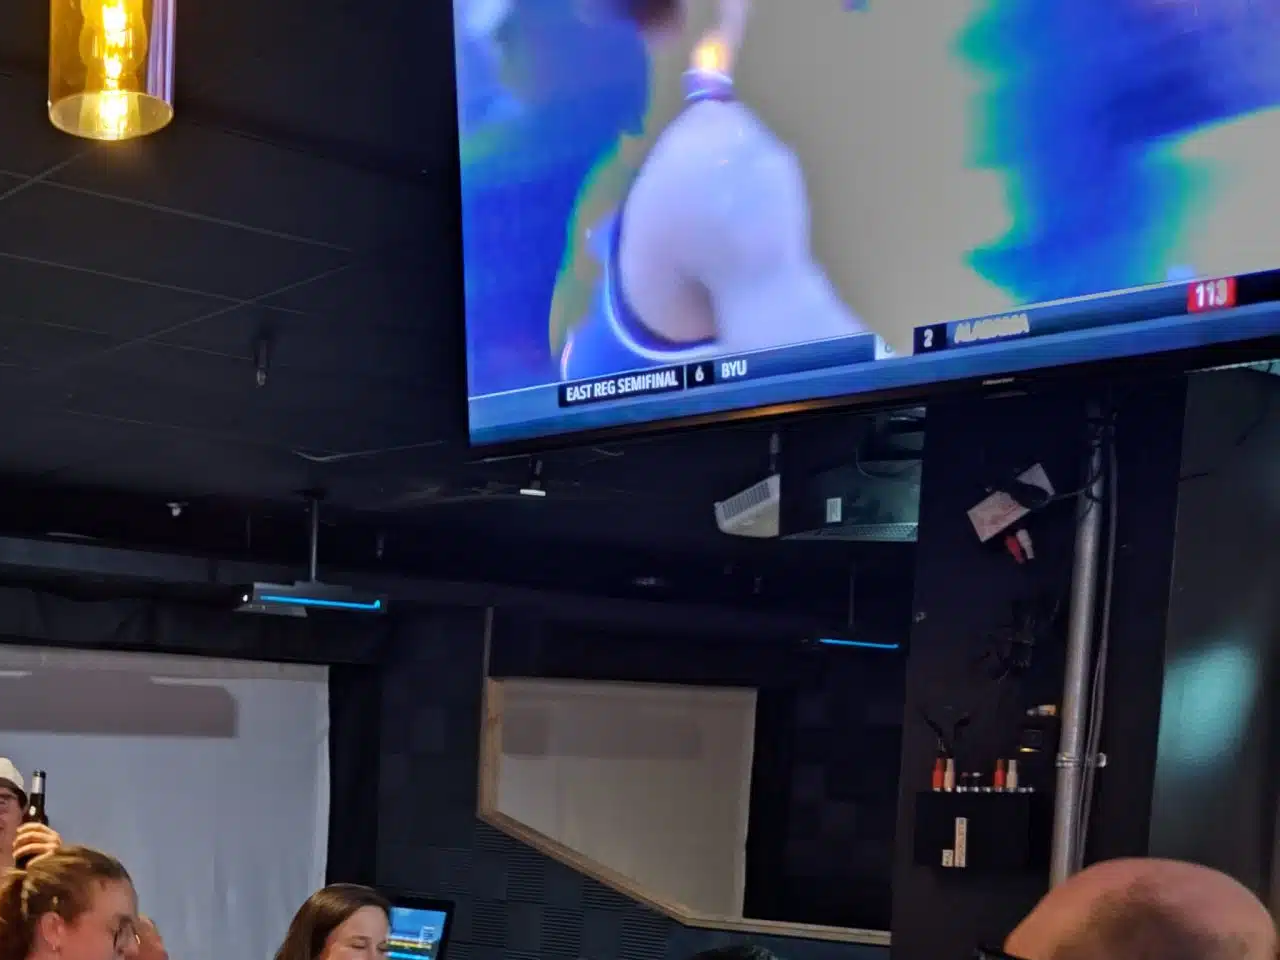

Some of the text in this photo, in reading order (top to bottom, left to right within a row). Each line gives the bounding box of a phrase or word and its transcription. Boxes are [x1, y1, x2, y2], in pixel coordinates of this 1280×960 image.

[923, 328, 933, 348] 2
[695, 359, 748, 382] 6 BYU
[566, 370, 679, 402] EAST REG SEMIFINAL
